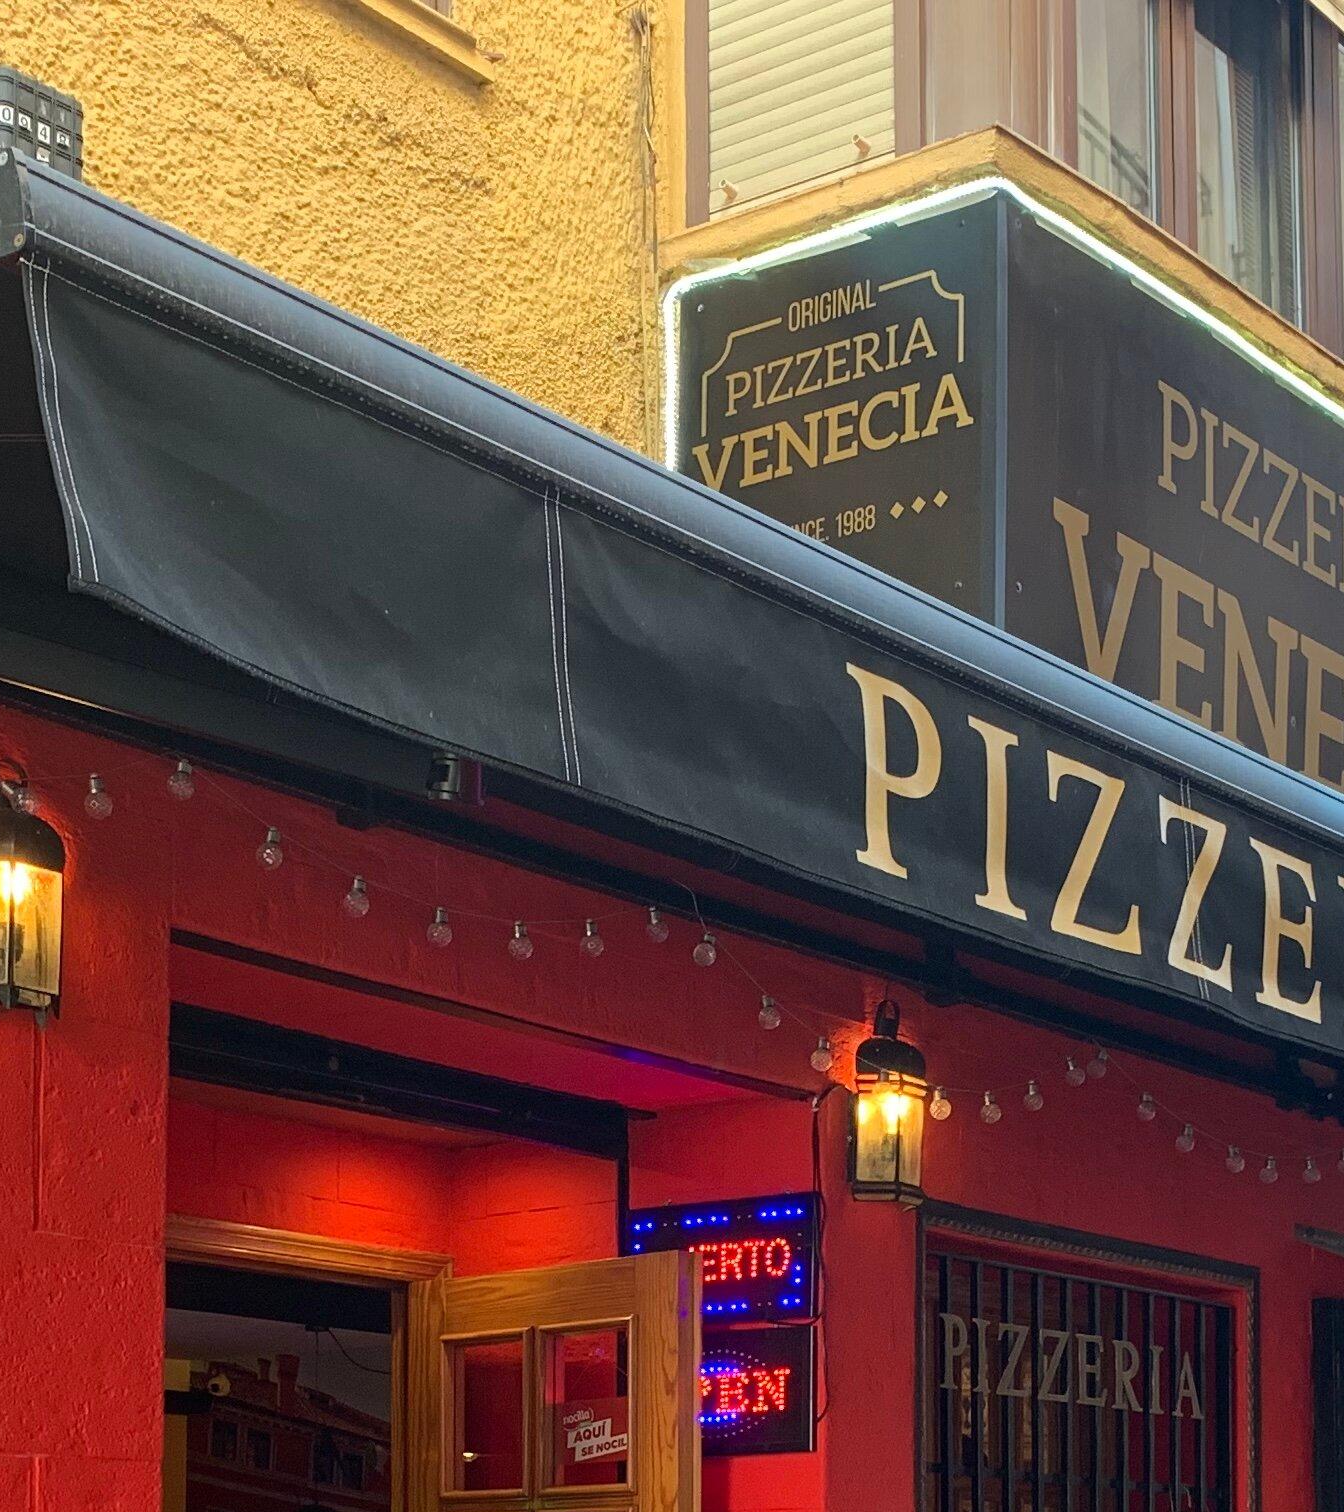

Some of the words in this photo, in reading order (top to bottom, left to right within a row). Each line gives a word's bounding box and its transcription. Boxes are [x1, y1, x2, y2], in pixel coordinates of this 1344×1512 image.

[787, 278, 877, 333] ORIGINAL
[724, 316, 938, 417] PIZZERIA
[692, 373, 974, 491] VENECIA
[835, 505, 876, 539] 1988
[689, 1237, 791, 1282] ERTO
[939, 1312, 1204, 1420] PIZZERIA
[573, 1421, 607, 1444] AQUÍ
[581, 1445, 594, 1457] SE
